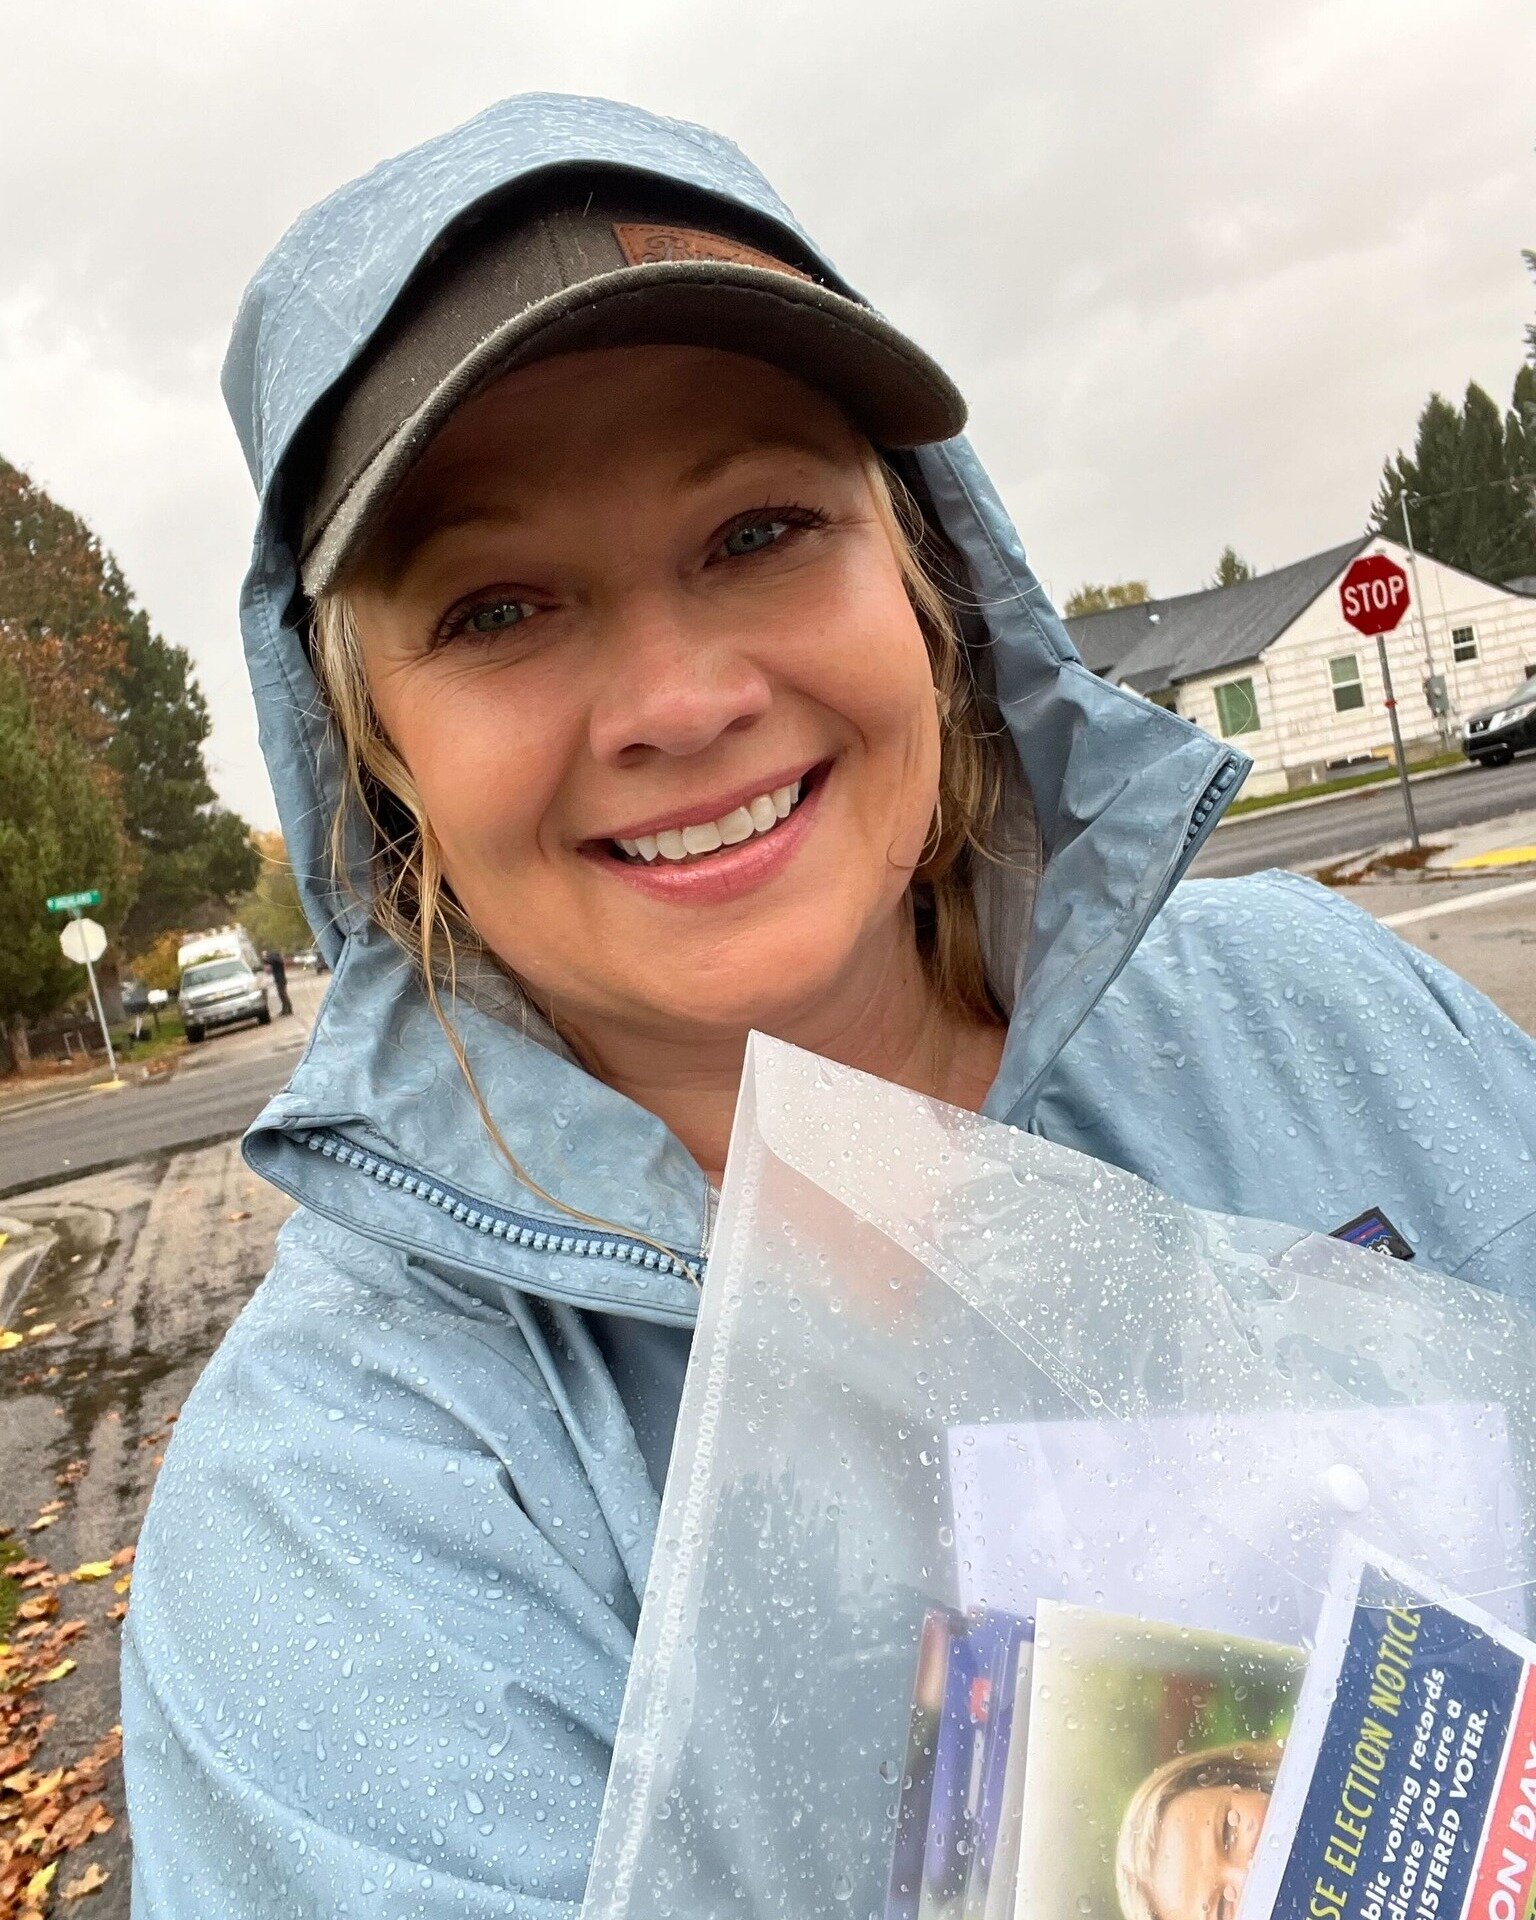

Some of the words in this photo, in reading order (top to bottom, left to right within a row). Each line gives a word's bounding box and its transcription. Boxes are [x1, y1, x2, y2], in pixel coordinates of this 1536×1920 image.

[1344, 575, 1404, 616] STOP
[1324, 1716, 1393, 1877] ELECTION
[1382, 1775, 1421, 1863] voting
[1409, 1668, 1445, 1771] records
[1415, 1808, 1461, 1920] ISTERED
[1449, 1709, 1489, 1799] VOTER.
[1416, 1778, 1441, 1837] you
[1434, 1725, 1456, 1773] are
[1447, 1699, 1463, 1719] a
[1305, 1876, 1348, 1920] SE
